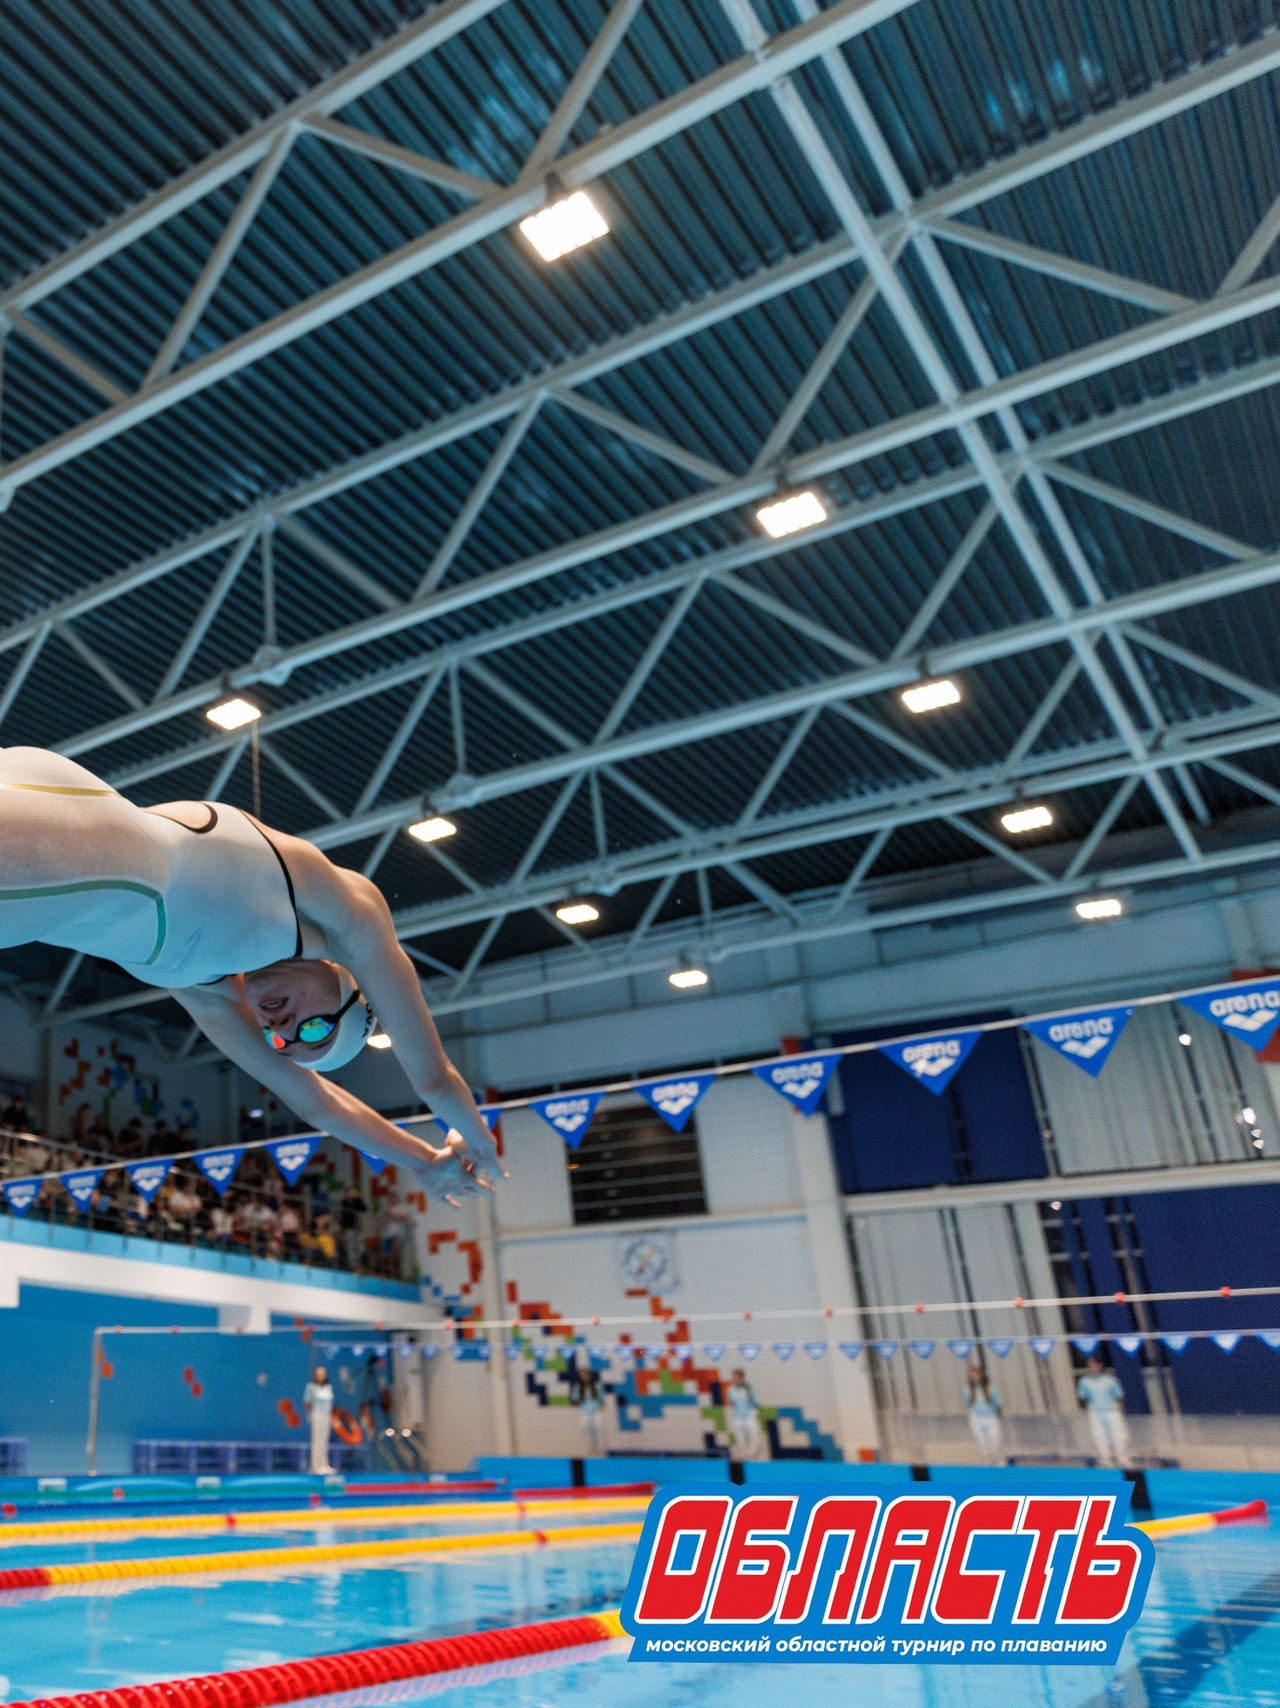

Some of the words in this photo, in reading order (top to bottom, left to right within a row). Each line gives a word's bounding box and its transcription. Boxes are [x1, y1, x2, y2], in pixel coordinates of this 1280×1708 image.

[1209, 989, 1280, 1017] arena
[1048, 1017, 1114, 1042] arena
[902, 1039, 961, 1064] arena
